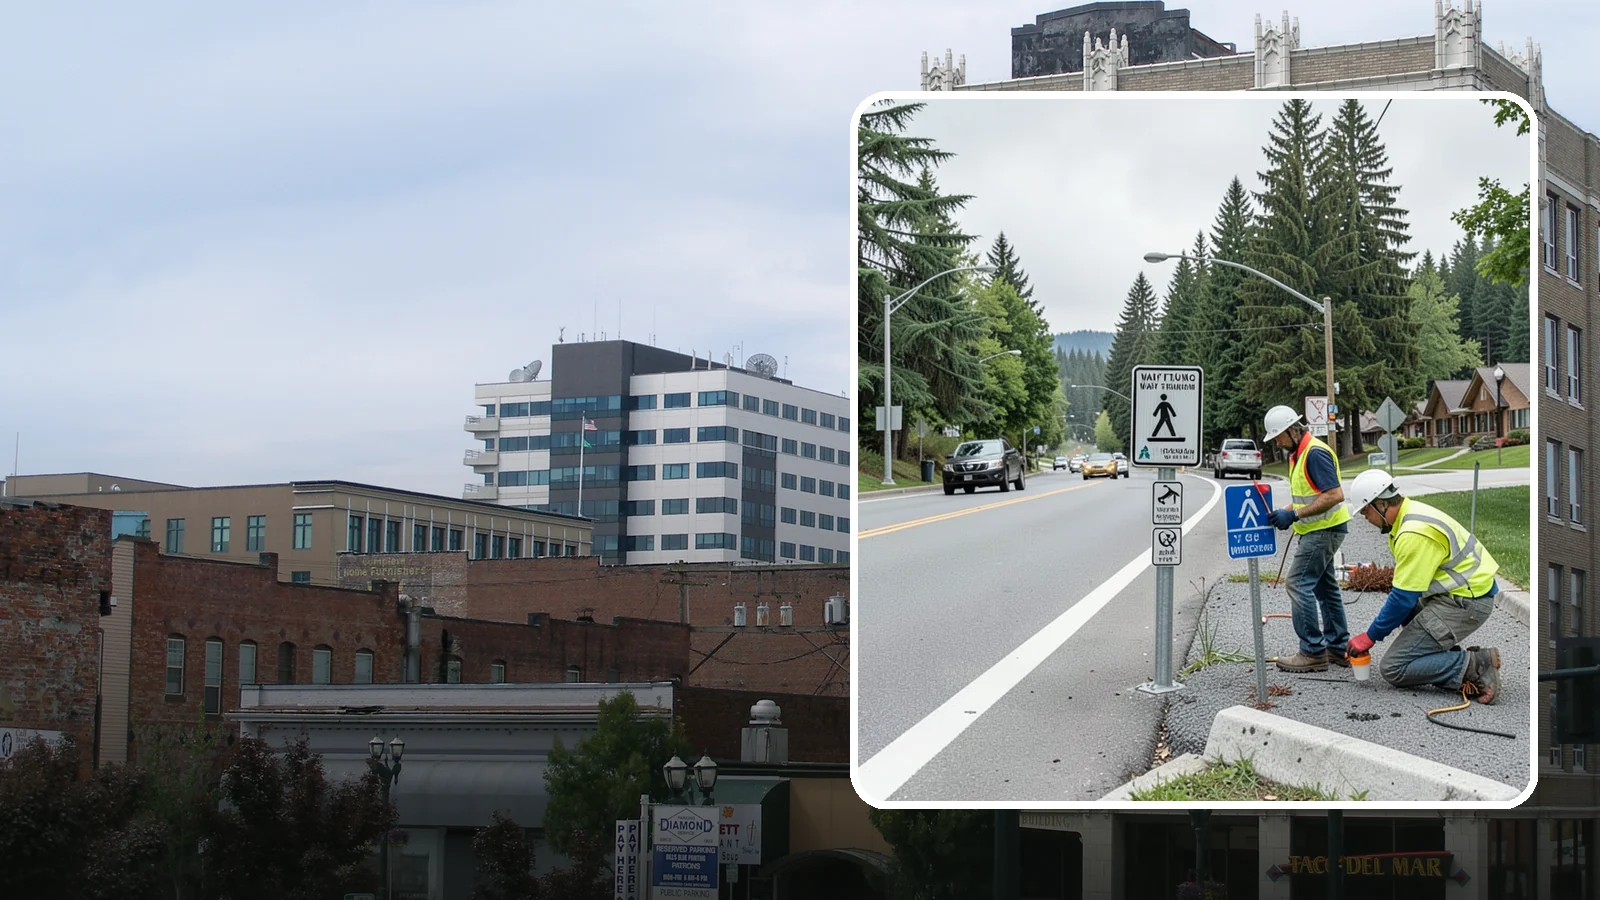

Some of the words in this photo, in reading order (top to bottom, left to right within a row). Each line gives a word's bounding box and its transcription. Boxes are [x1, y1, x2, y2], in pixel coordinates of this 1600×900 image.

[660, 818, 713, 833] DIAMOND
[1022, 815, 1070, 828] BUILDING
[719, 824, 740, 836] ETT
[617, 825, 625, 852] PAY
[628, 824, 637, 852] PAY
[656, 845, 688, 853] RESERVED
[689, 846, 716, 854] PARKING
[721, 852, 739, 862] Soup
[671, 862, 701, 870] PATRONS
[1345, 856, 1385, 876] DEL
[1392, 857, 1442, 877] MAR
[616, 856, 625, 894] HERE
[628, 855, 637, 893] HERE
[660, 888, 682, 898] PUBLIC
[683, 889, 710, 899] PARKING
